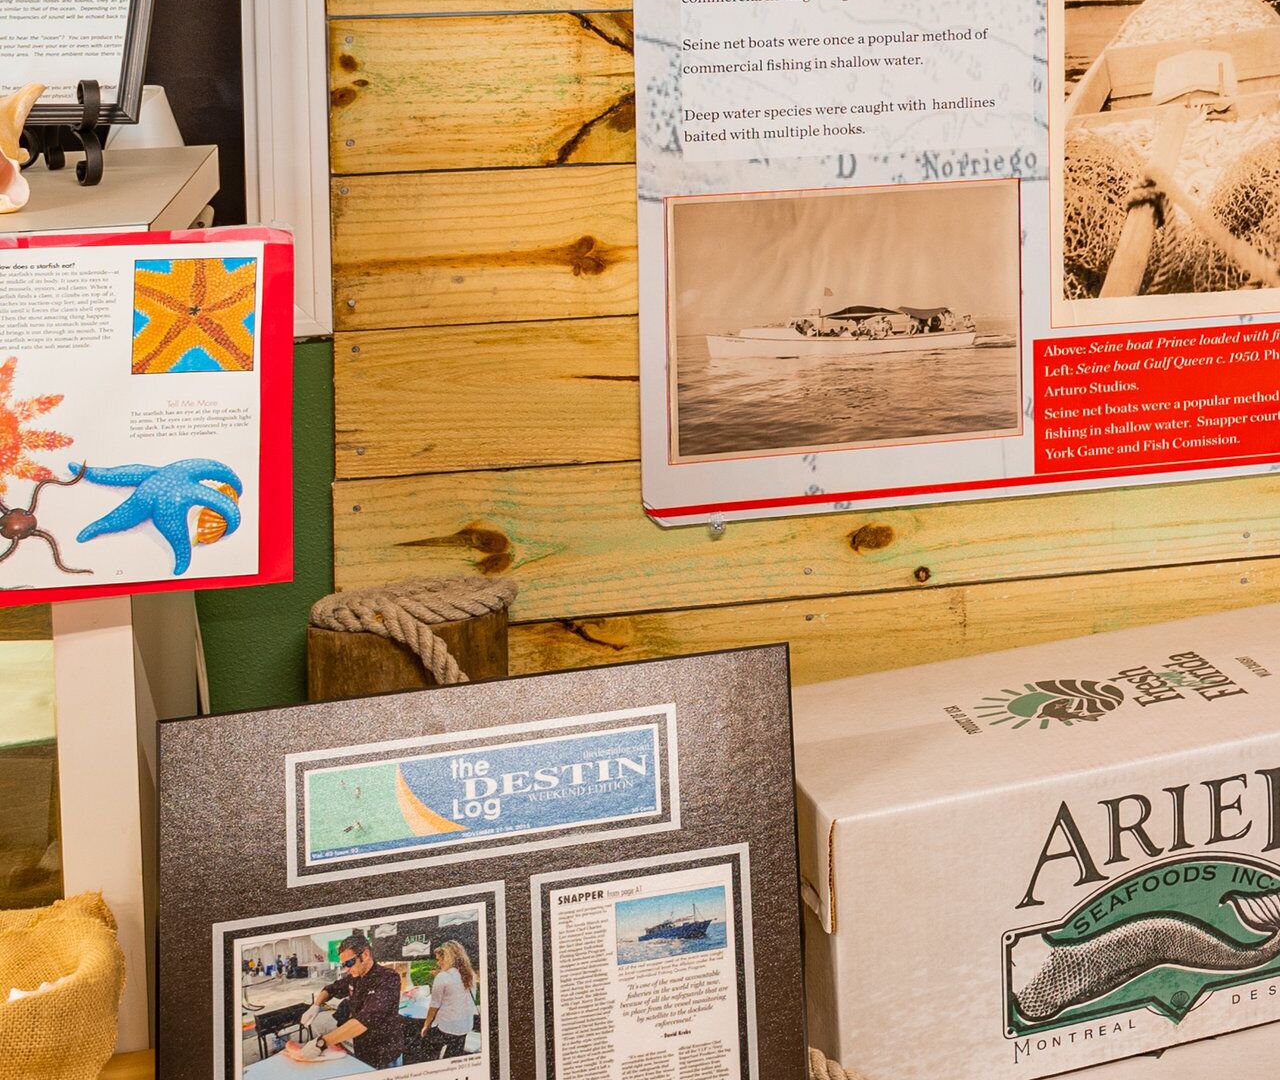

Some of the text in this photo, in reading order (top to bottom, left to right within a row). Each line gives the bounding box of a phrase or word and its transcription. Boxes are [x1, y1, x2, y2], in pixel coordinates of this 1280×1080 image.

[1044, 380, 1139, 397] Arturo Studios.
[1108, 666, 1186, 707] Fresh
[450, 758, 490, 779] the
[464, 754, 648, 800] DESTIN
[452, 796, 501, 821] Log
[558, 890, 604, 905] SNAPPER
[1072, 864, 1275, 936] SEAFOODS INC.
[1012, 1019, 1136, 1064] MONTREAL
